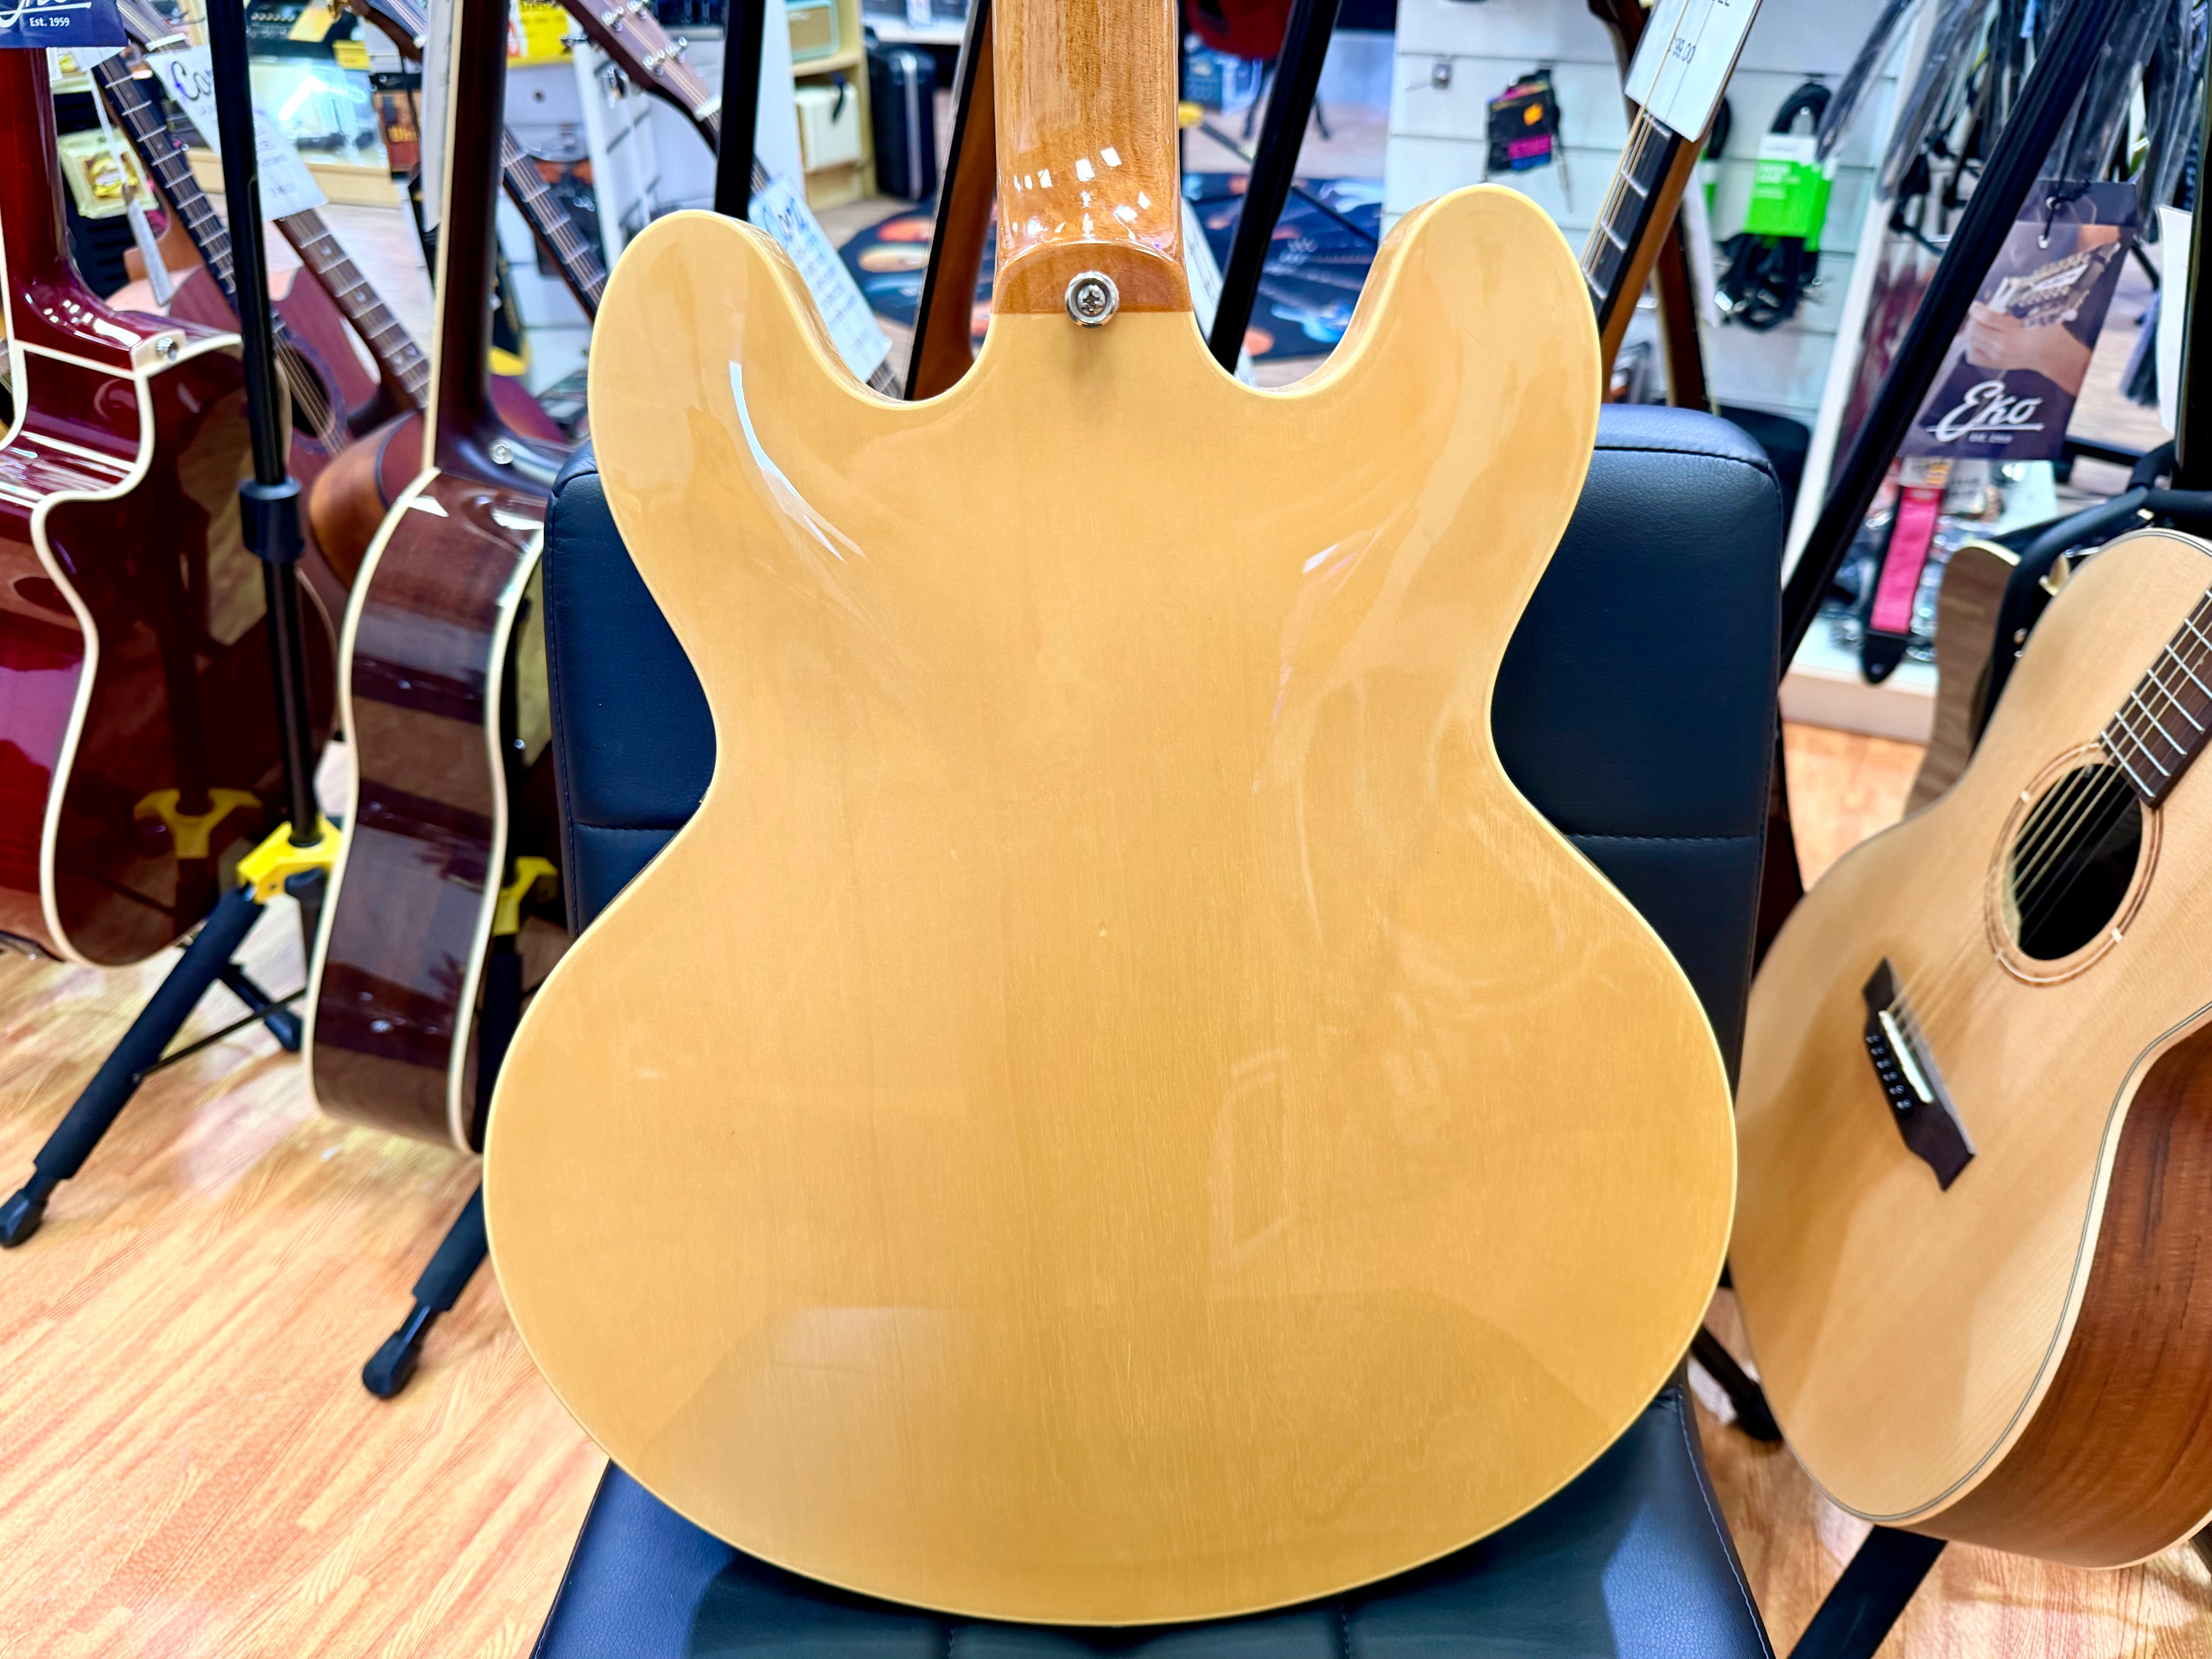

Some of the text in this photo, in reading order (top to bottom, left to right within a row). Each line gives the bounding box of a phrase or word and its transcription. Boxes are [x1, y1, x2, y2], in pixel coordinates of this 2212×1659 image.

[29, 17, 70, 26] Est. 1959
[1935, 380, 2043, 443] Eko
